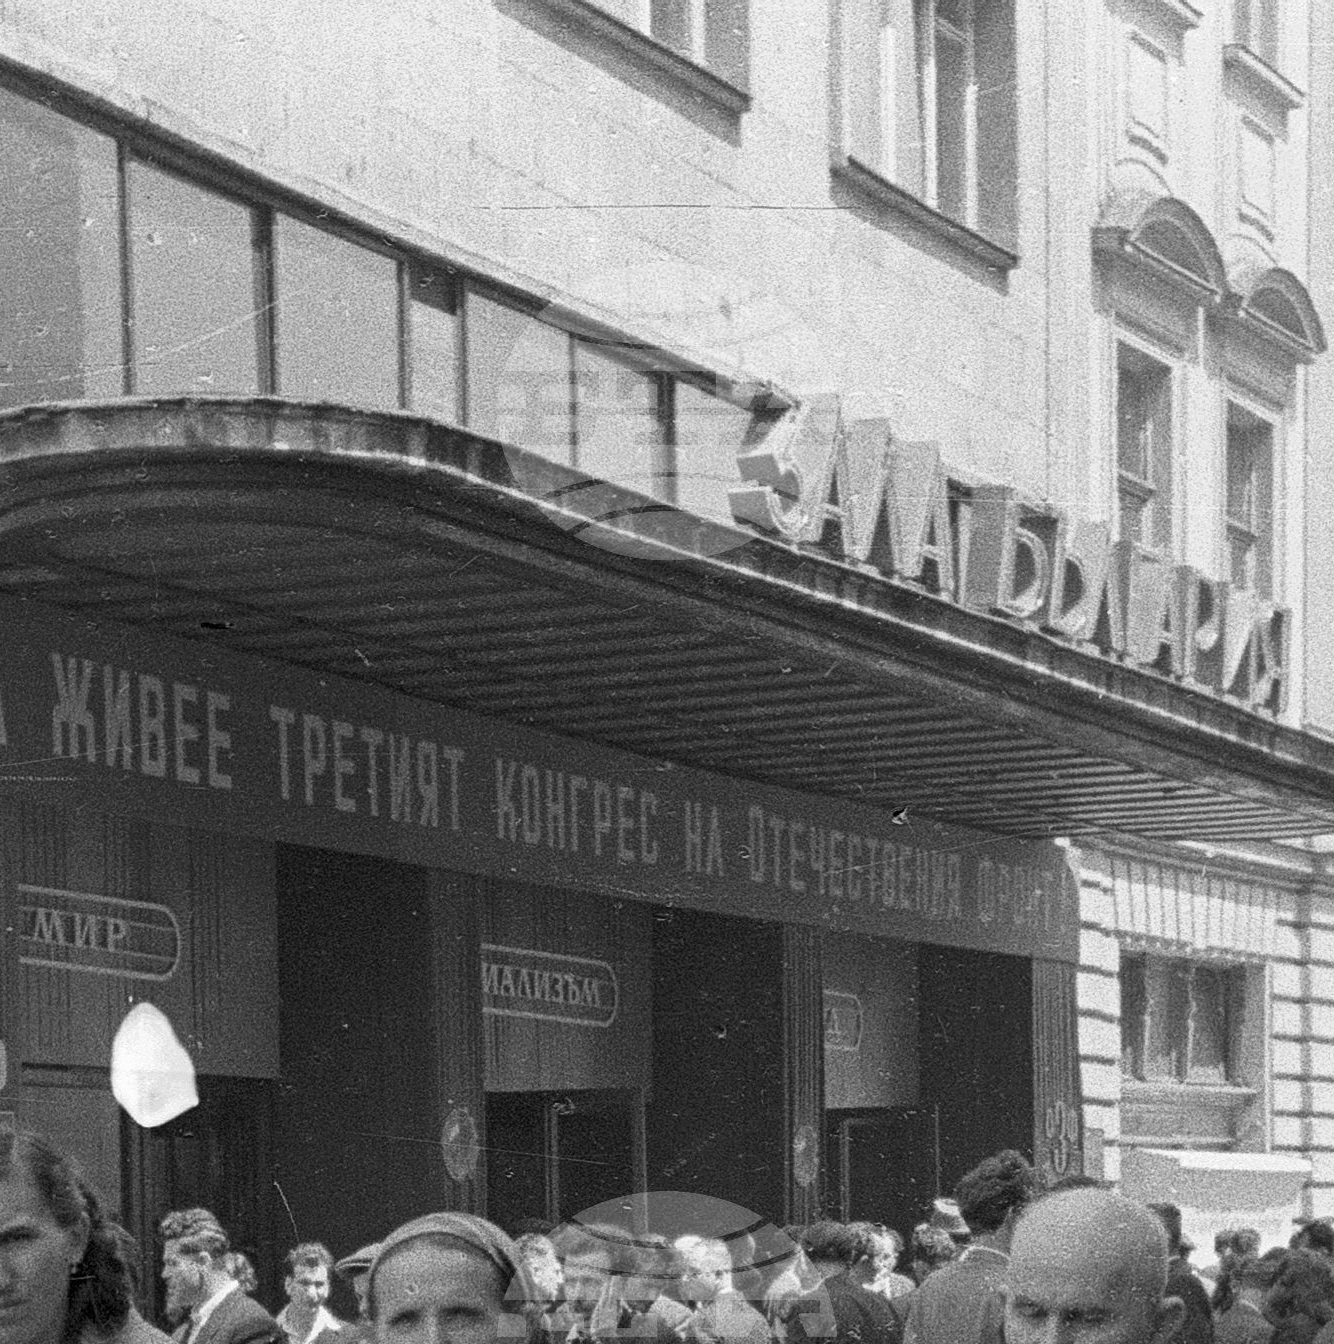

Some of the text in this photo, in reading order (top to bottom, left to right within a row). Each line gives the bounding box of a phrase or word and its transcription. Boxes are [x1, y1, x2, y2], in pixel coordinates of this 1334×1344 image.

[51, 652, 232, 790] ЖИВЕЕ
[269, 704, 466, 831] ТРЕТИЯТ
[495, 758, 659, 865] КОНГРЕС
[683, 801, 726, 878] НА
[748, 805, 962, 920] ОТЕЧЕСТВЕНИЯ
[32, 906, 128, 952] МИР
[481, 962, 601, 1008] ИАЛИЗЪМ
